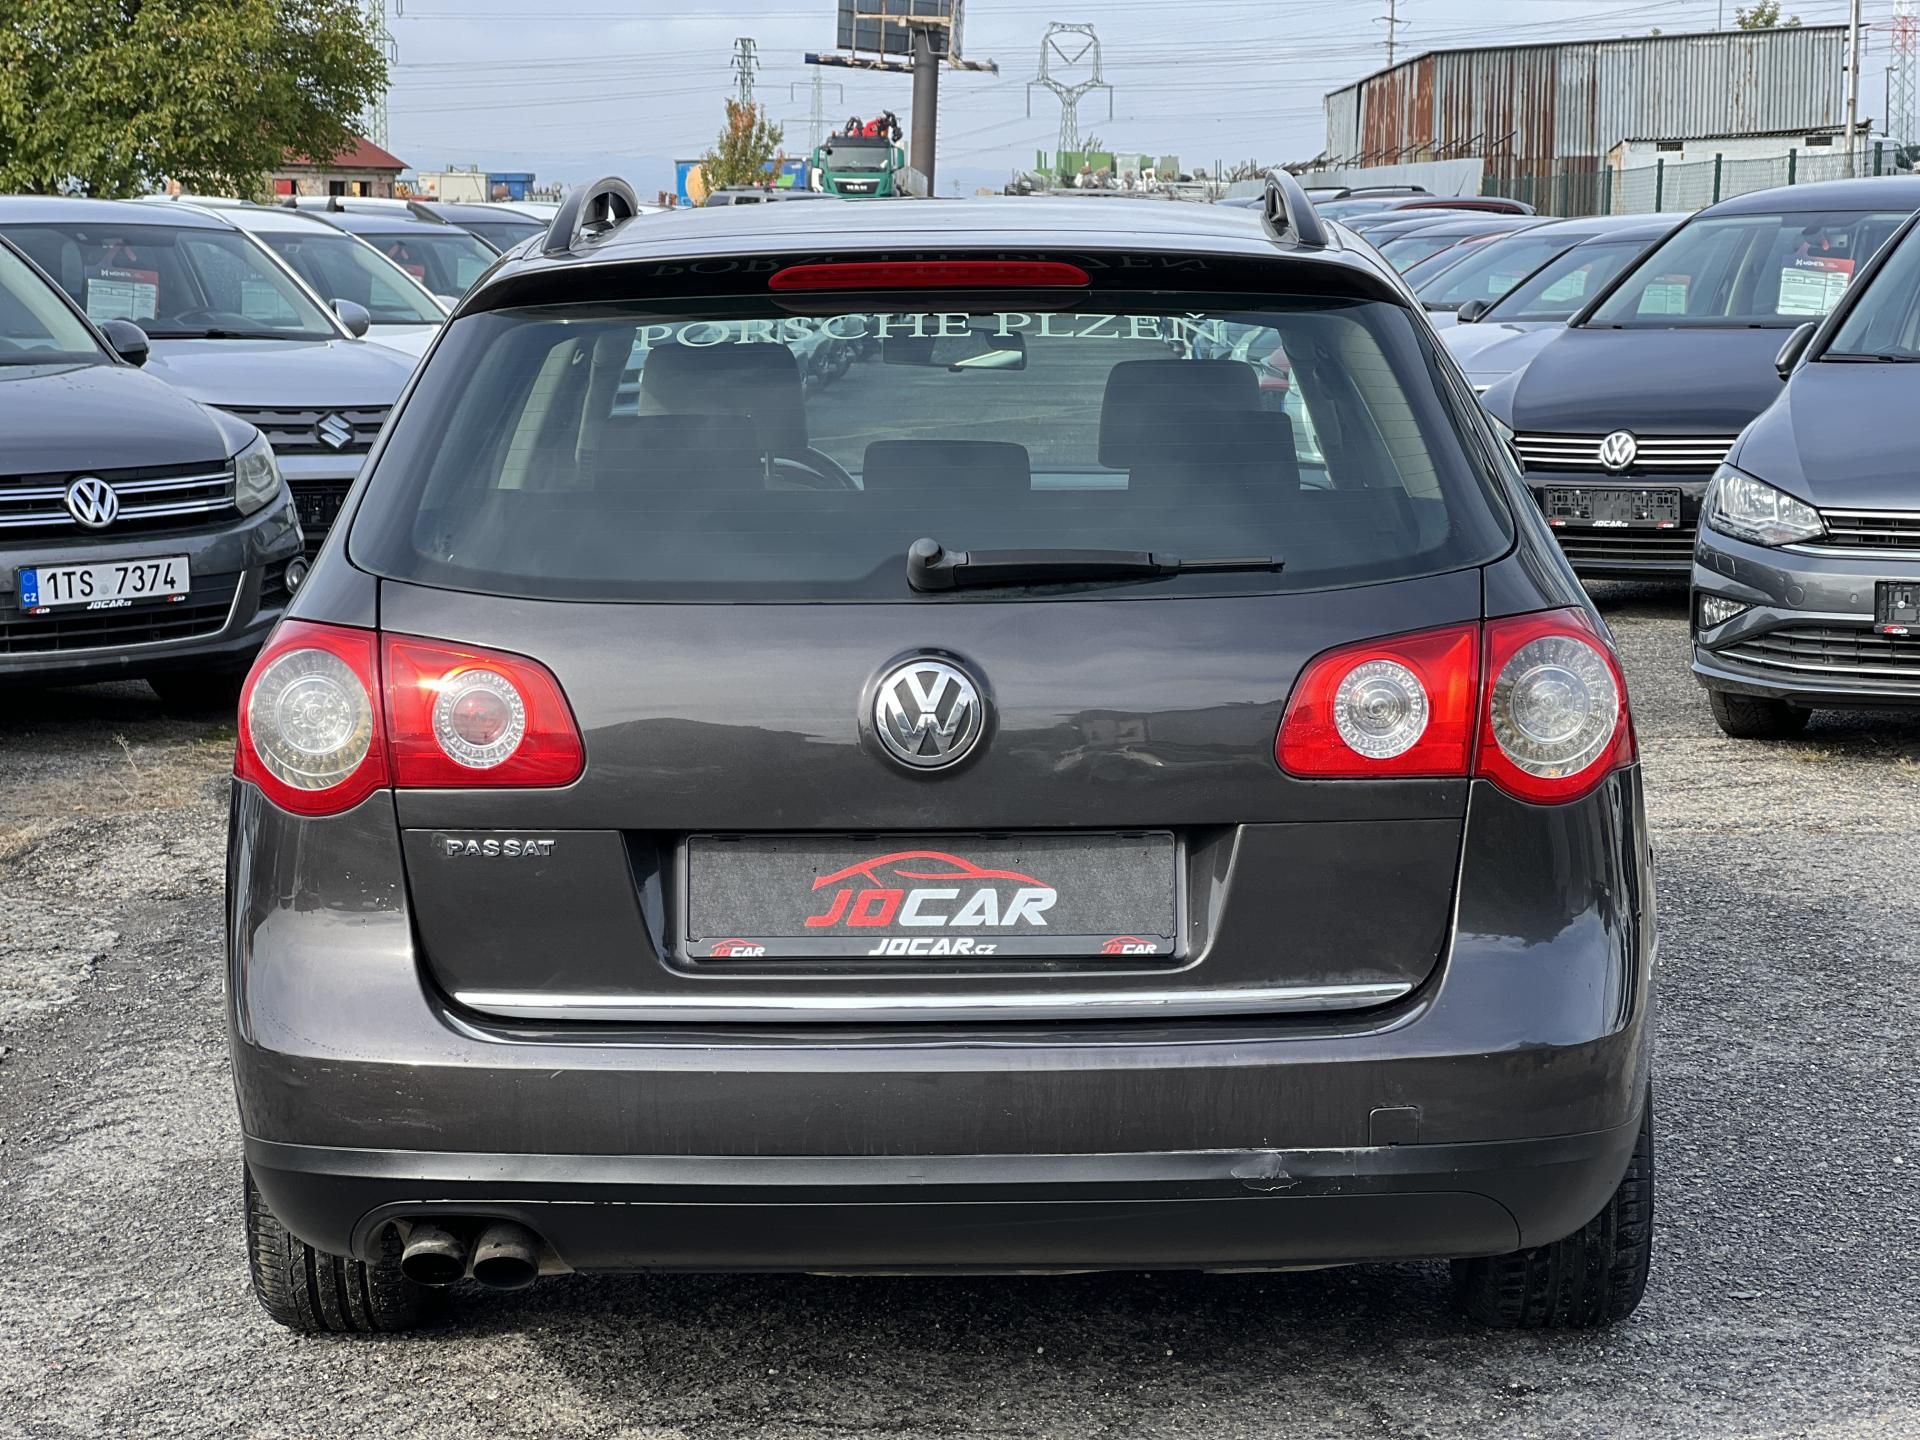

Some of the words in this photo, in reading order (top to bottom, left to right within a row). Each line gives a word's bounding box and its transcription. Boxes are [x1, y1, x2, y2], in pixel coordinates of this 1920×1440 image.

[634, 312, 973, 351] PORSCHE
[992, 311, 1226, 343] PLZEŇ
[46, 570, 94, 600] 1TS
[115, 562, 176, 594] 7374
[23, 592, 37, 602] CZ
[446, 839, 556, 857] PASSAT
[804, 888, 1057, 927] JOCAR
[709, 946, 766, 957] JOCAR
[1100, 943, 1157, 955] JOCAR
